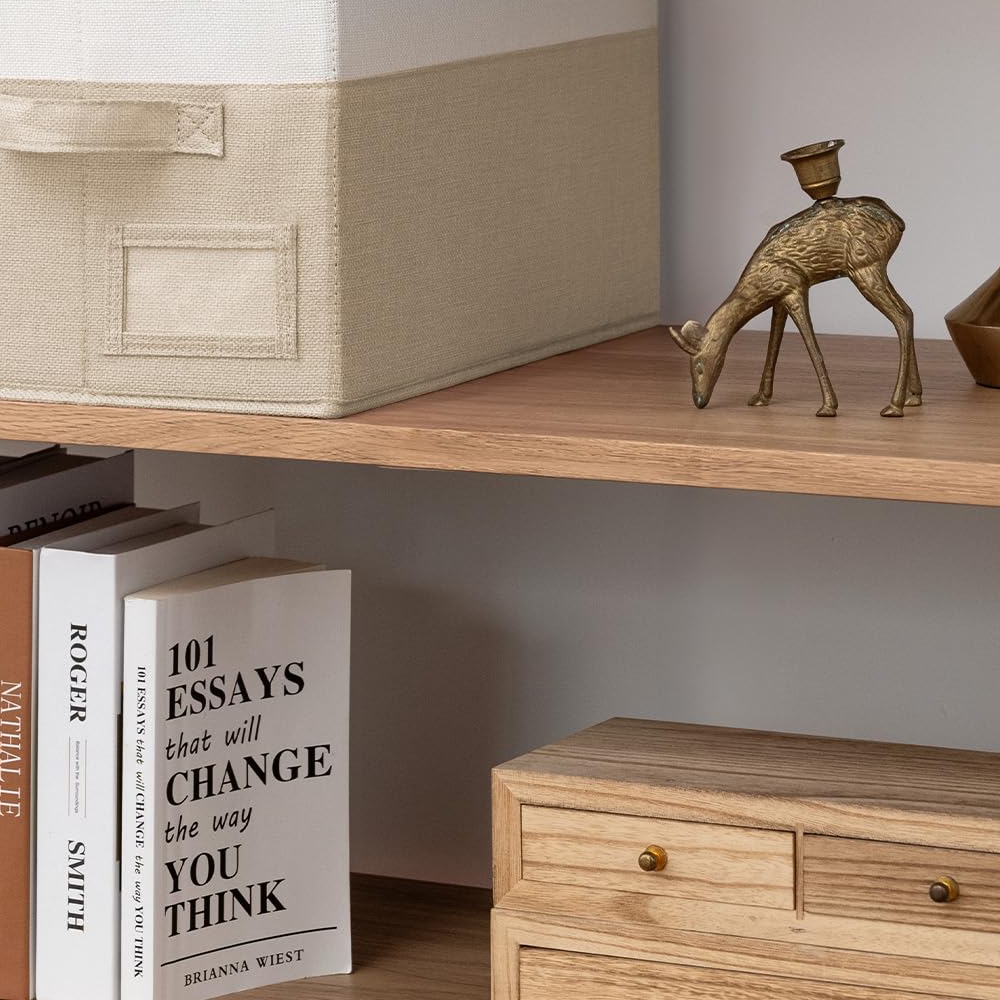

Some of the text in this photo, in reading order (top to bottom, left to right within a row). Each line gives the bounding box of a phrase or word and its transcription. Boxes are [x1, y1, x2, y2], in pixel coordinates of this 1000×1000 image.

[69, 622, 88, 722] ROGER
[168, 635, 217, 678] 101
[165, 661, 305, 721] ESSAYS
[165, 714, 262, 761] that will
[166, 744, 333, 807] CHANGE
[132, 666, 147, 978] 101 ESSAYS that will CHANGE the way YOU THINK
[164, 807, 253, 844] the way
[66, 839, 86, 933] SMITH
[164, 844, 242, 895] YOU
[164, 878, 287, 938] THINK
[184, 949, 305, 987] BRIANNA WIEST
